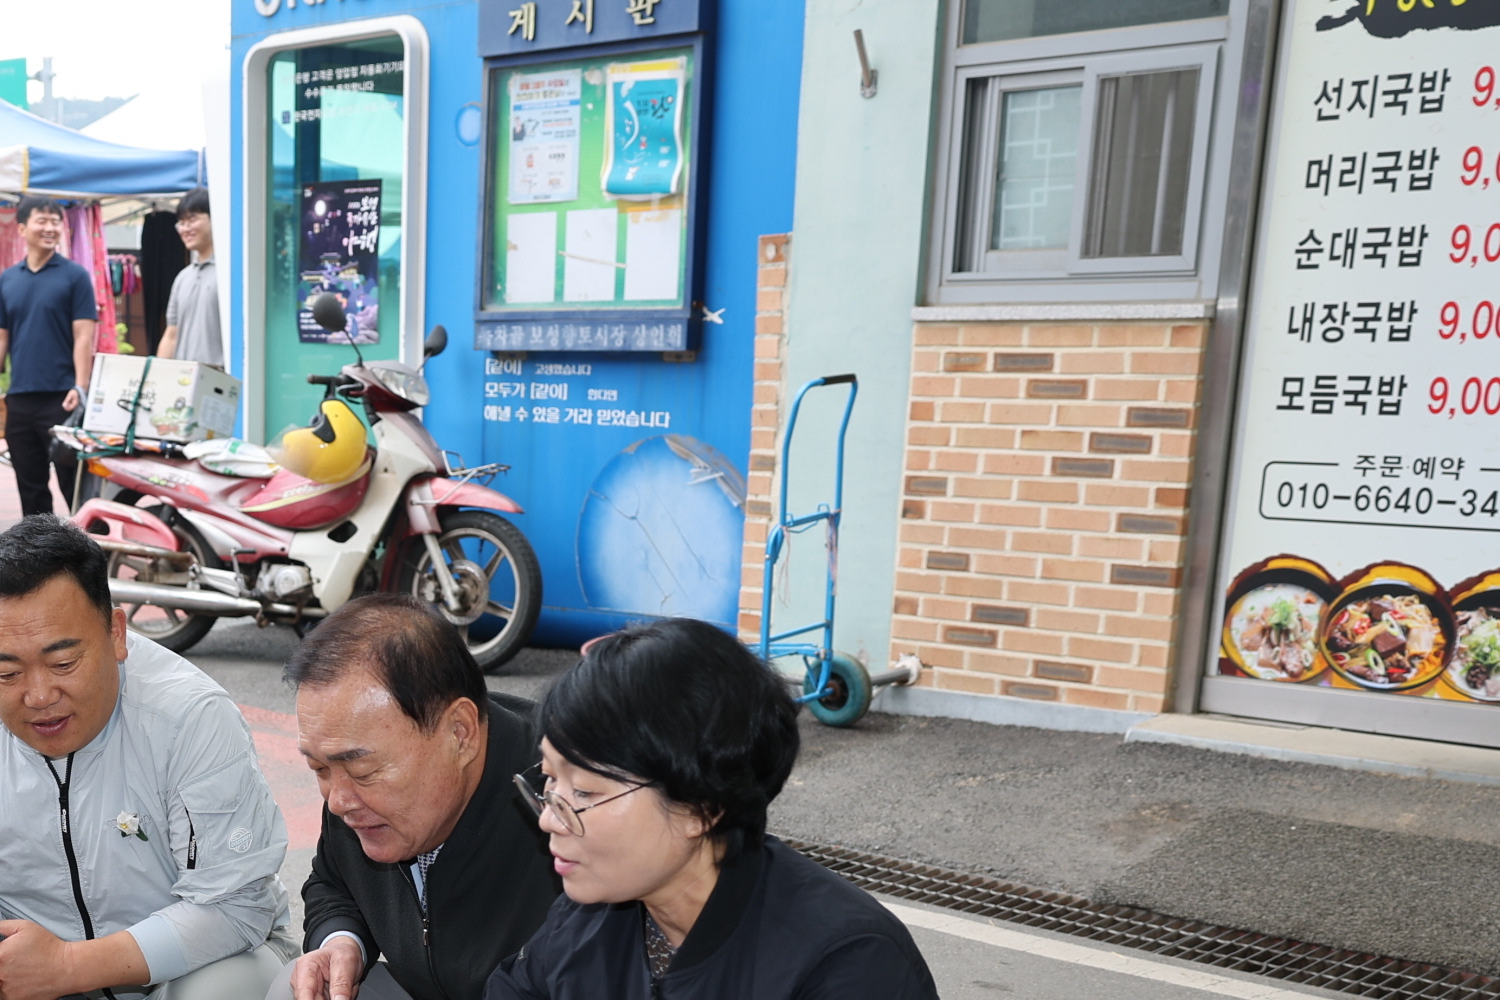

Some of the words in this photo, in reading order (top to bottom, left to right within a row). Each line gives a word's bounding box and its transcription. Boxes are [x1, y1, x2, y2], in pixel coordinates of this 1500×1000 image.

[1313, 68, 1451, 121] 선지국밥
[1305, 147, 1440, 196] 머리국밥
[1294, 224, 1429, 270] 순대국밥
[632, 324, 683, 347] 상인회
[1287, 300, 1418, 343] 내장국밥
[484, 382, 527, 398] 모두가
[1276, 375, 1408, 415] 모듬국밥
[484, 405, 511, 422] 해낼
[515, 407, 529, 422] 수
[532, 406, 560, 424] 있을
[564, 408, 593, 425] 거라
[597, 410, 671, 428] 믿었습니다
[1277, 482, 1500, 517] 010-6640-34
